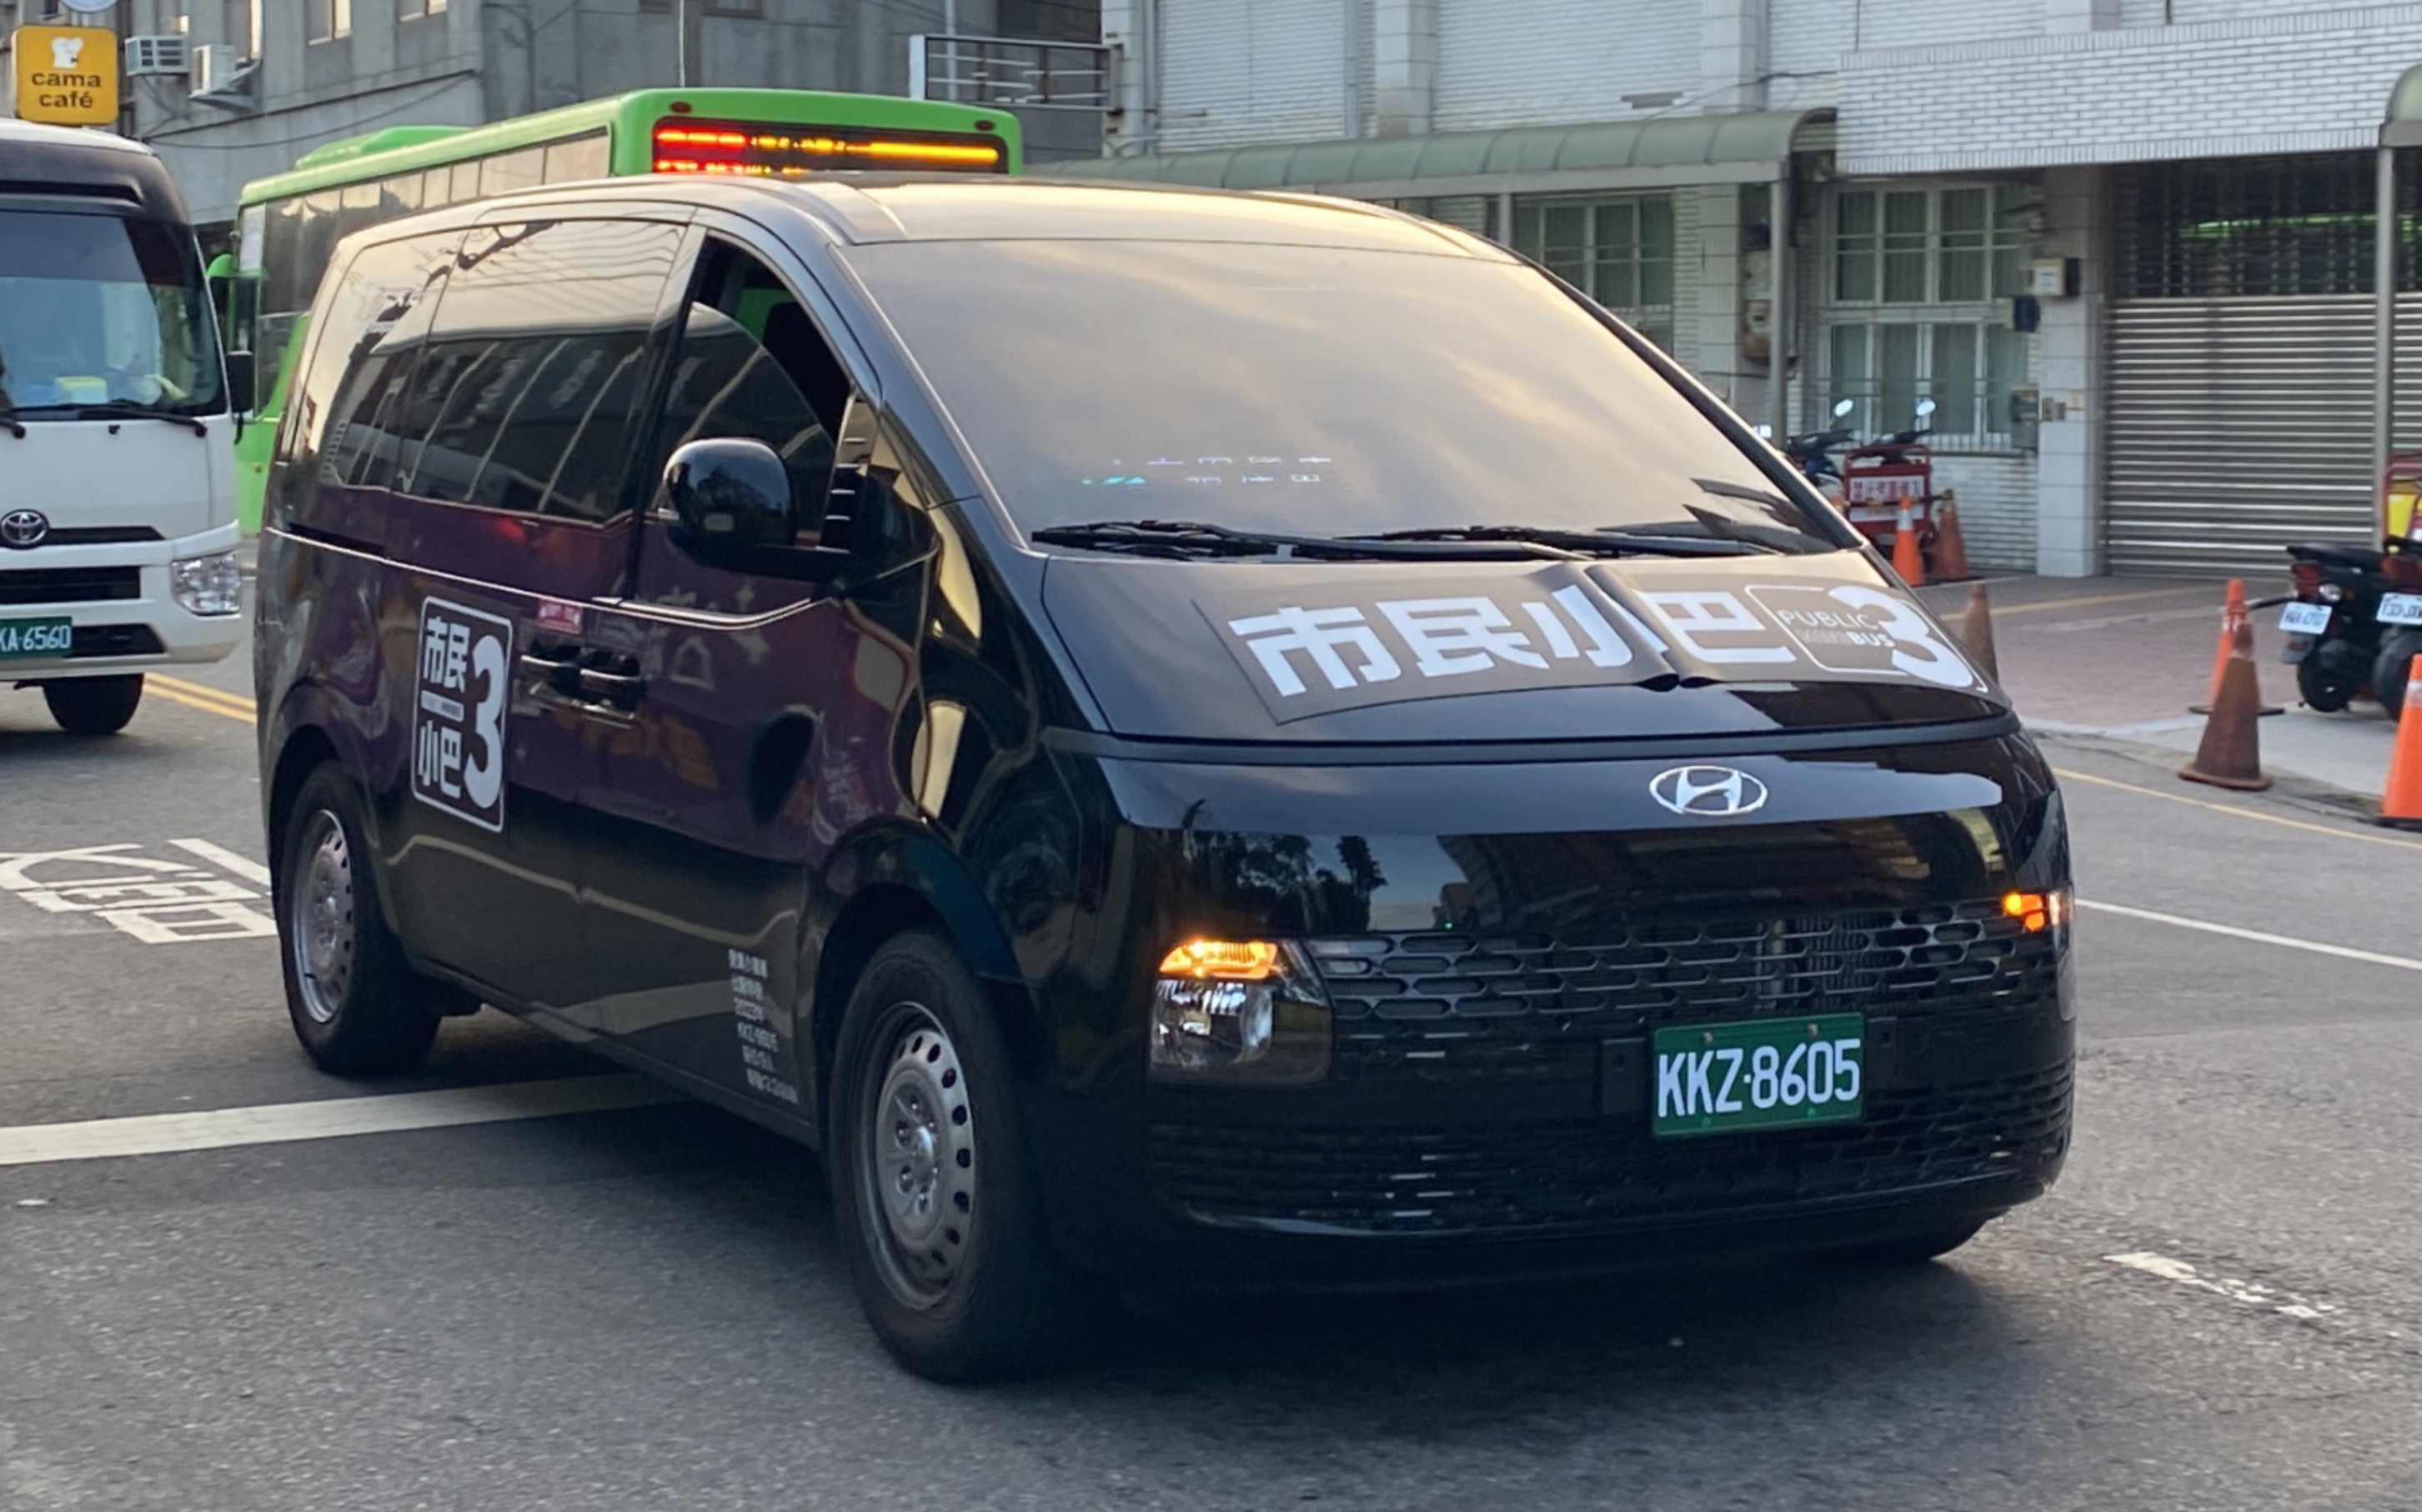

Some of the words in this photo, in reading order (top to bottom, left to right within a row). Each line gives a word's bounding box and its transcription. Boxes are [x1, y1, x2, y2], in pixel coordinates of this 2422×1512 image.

[32, 73, 101, 88] cama
[39, 91, 93, 108] café
[423, 615, 471, 693] 市民
[1228, 583, 1797, 698] 市民小巴
[1828, 586, 1973, 688] 3
[1776, 609, 1879, 630] PUBLIC
[418, 719, 463, 799] 小巴
[464, 634, 506, 809] 3
